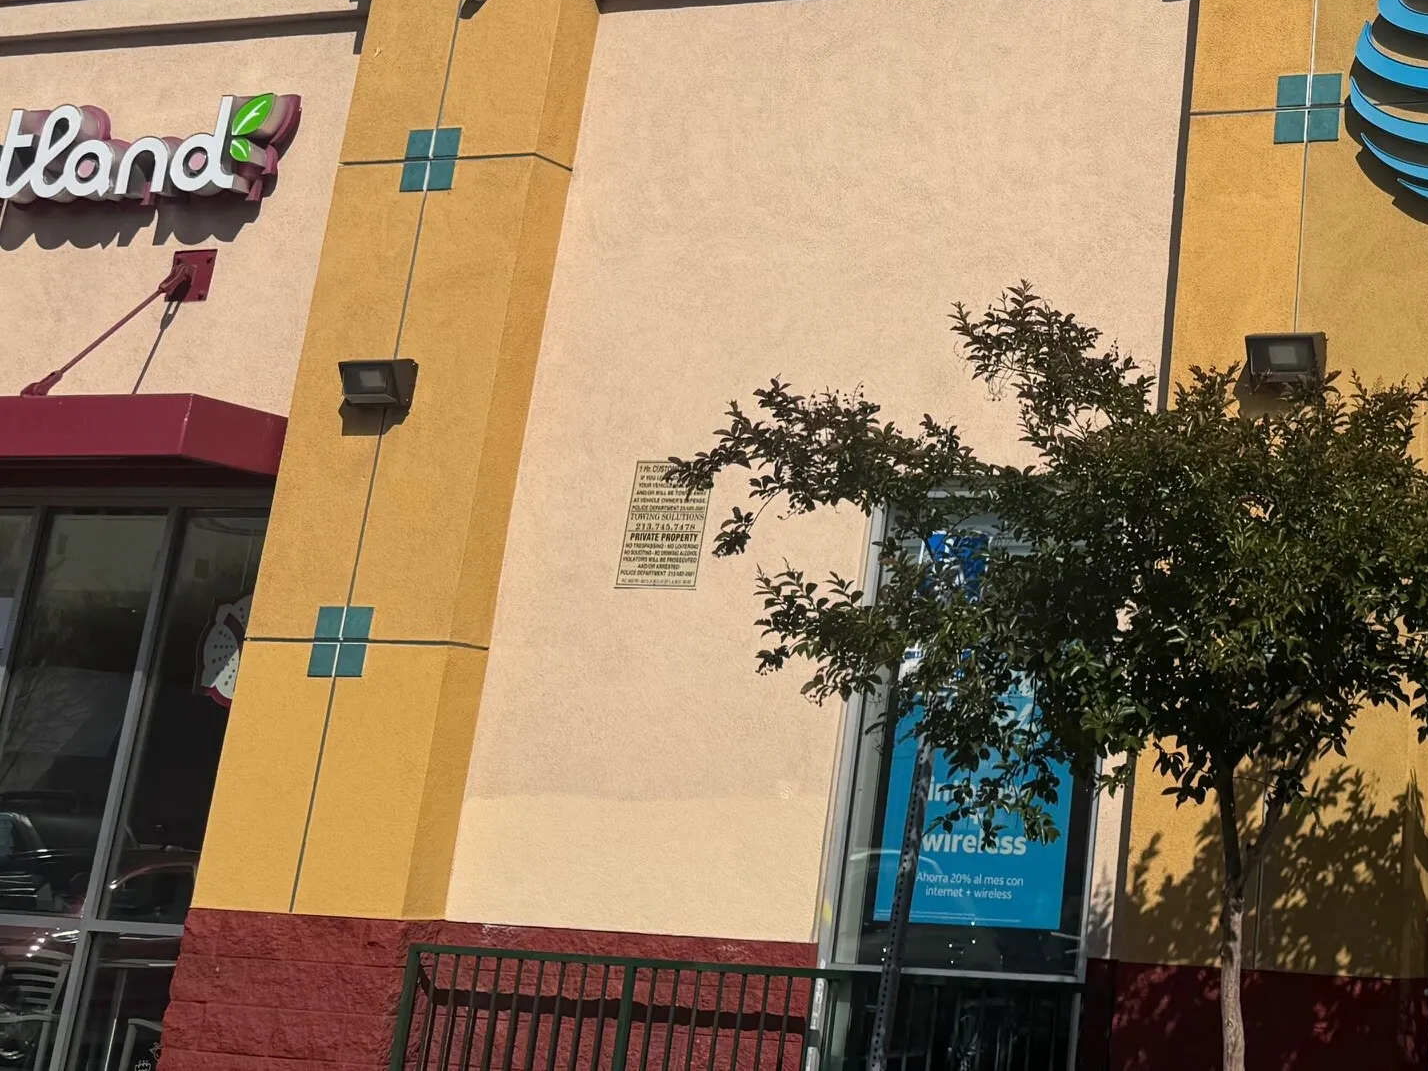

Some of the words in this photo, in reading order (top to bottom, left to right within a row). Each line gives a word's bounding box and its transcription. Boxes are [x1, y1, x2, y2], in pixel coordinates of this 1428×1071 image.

[0, 95, 235, 199] tland
[630, 513, 660, 521] TOWING
[661, 513, 704, 521] SOLUTIONS
[630, 532, 660, 542] PRIVATE
[661, 533, 699, 542] PROPERTY
[916, 872, 949, 883] Ahorra
[950, 873, 971, 884] 20%
[973, 874, 982, 885] al
[983, 876, 1004, 886] mes
[1006, 877, 1024, 887] con
[925, 885, 963, 898] internet
[973, 888, 1012, 900] wireless
